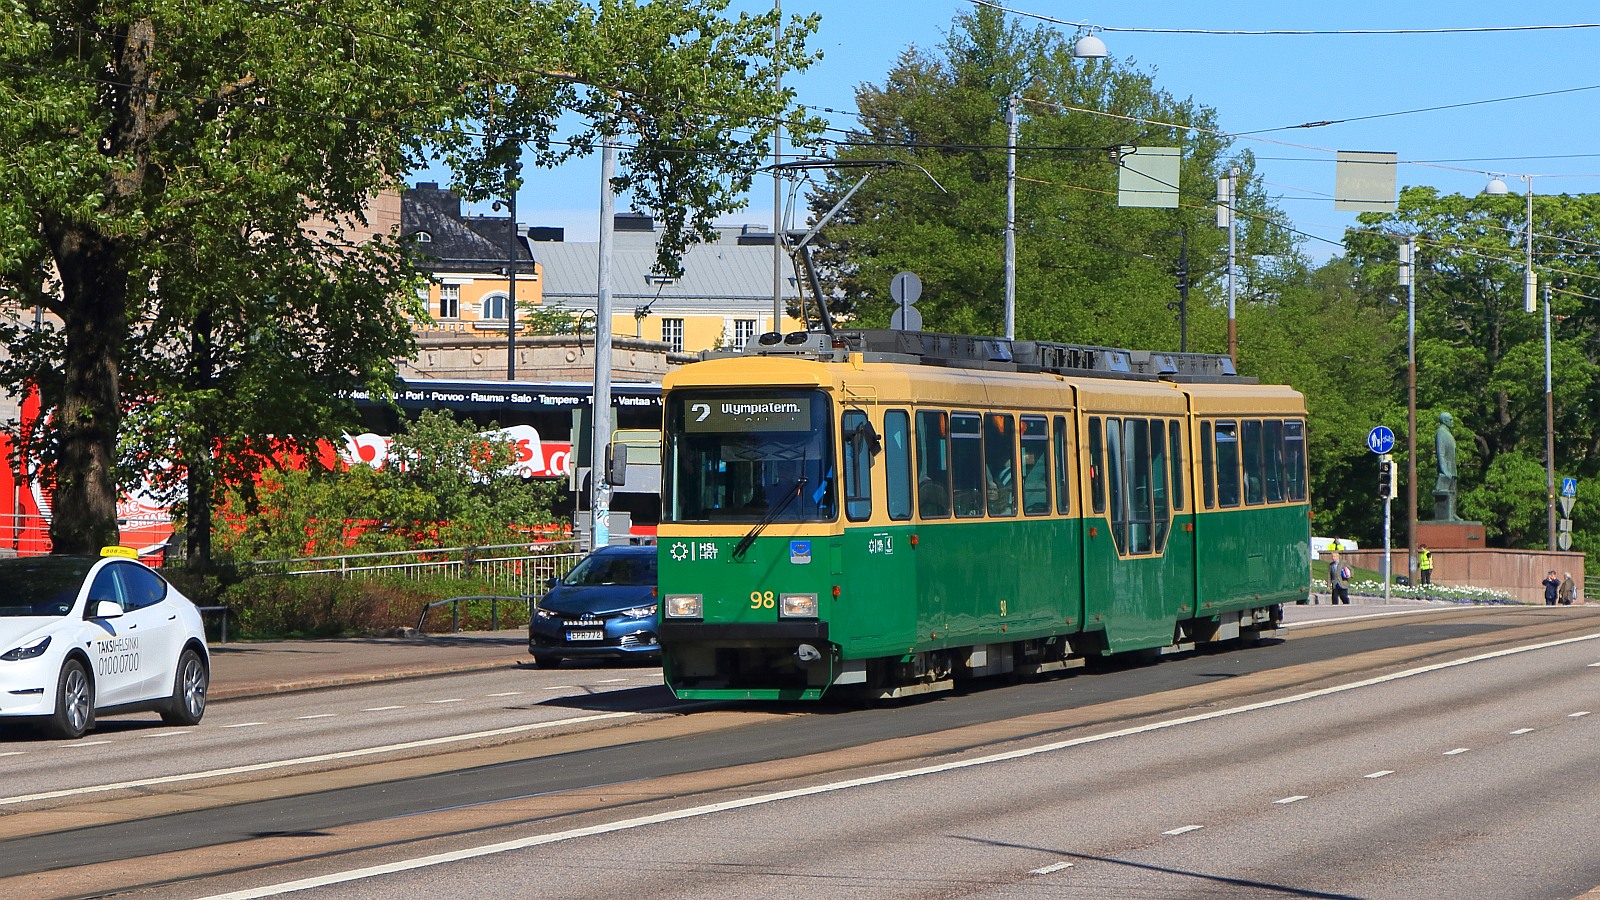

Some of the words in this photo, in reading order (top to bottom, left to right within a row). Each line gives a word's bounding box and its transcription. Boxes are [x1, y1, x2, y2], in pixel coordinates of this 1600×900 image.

[405, 391, 424, 400] Pori
[431, 391, 465, 402] Porvoo
[471, 393, 504, 403] Rauma
[511, 393, 531, 403] Salo
[538, 394, 579, 405] Tampere
[618, 396, 651, 406] Vantaa
[691, 403, 711, 422] 2
[699, 543, 718, 551] HSL
[699, 551, 718, 560] HRT
[750, 590, 775, 609] 98
[98, 655, 119, 676] 0100
[119, 652, 139, 673] 0700
